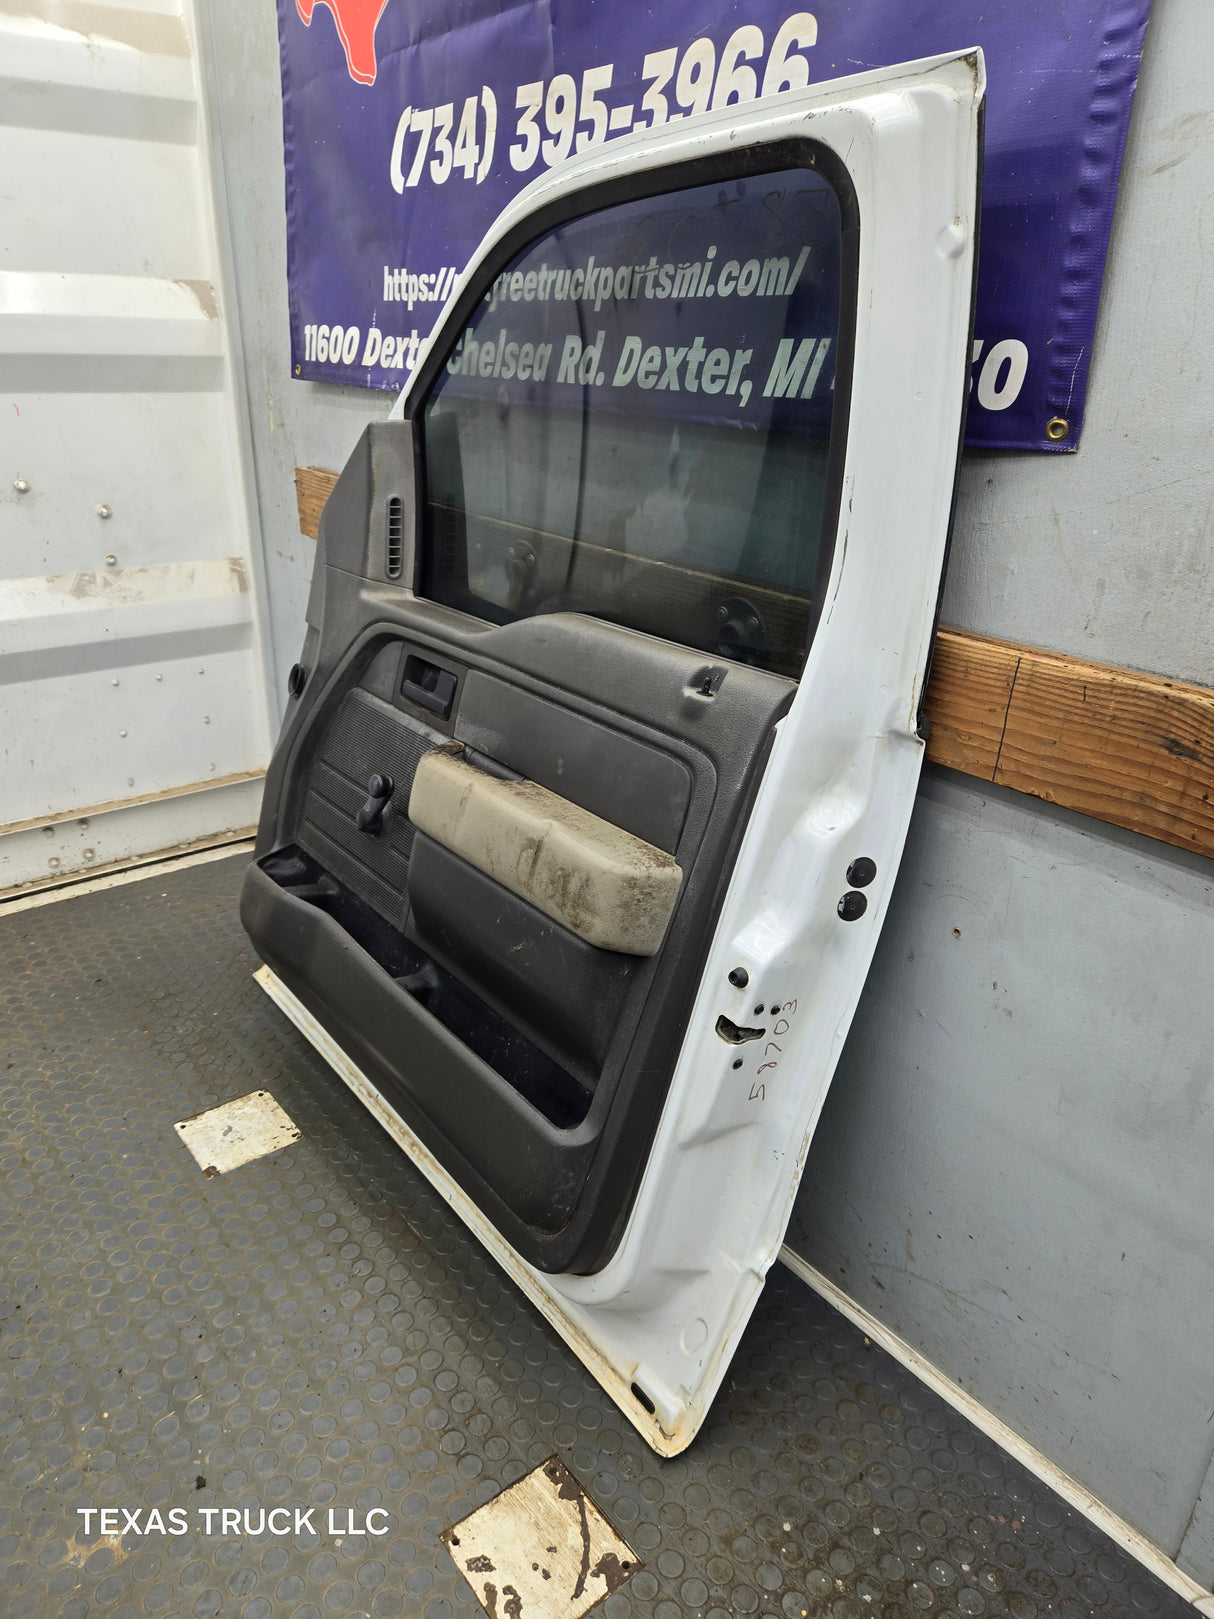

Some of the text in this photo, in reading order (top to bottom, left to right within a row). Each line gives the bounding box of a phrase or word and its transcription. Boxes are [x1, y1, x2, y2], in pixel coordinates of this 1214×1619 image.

[390, 12, 818, 194] (734) 395-3966
[304, 324, 360, 365] 11600
[556, 331, 605, 387] Rd.
[612, 335, 754, 408] Dexter,
[762, 338, 832, 400] MI
